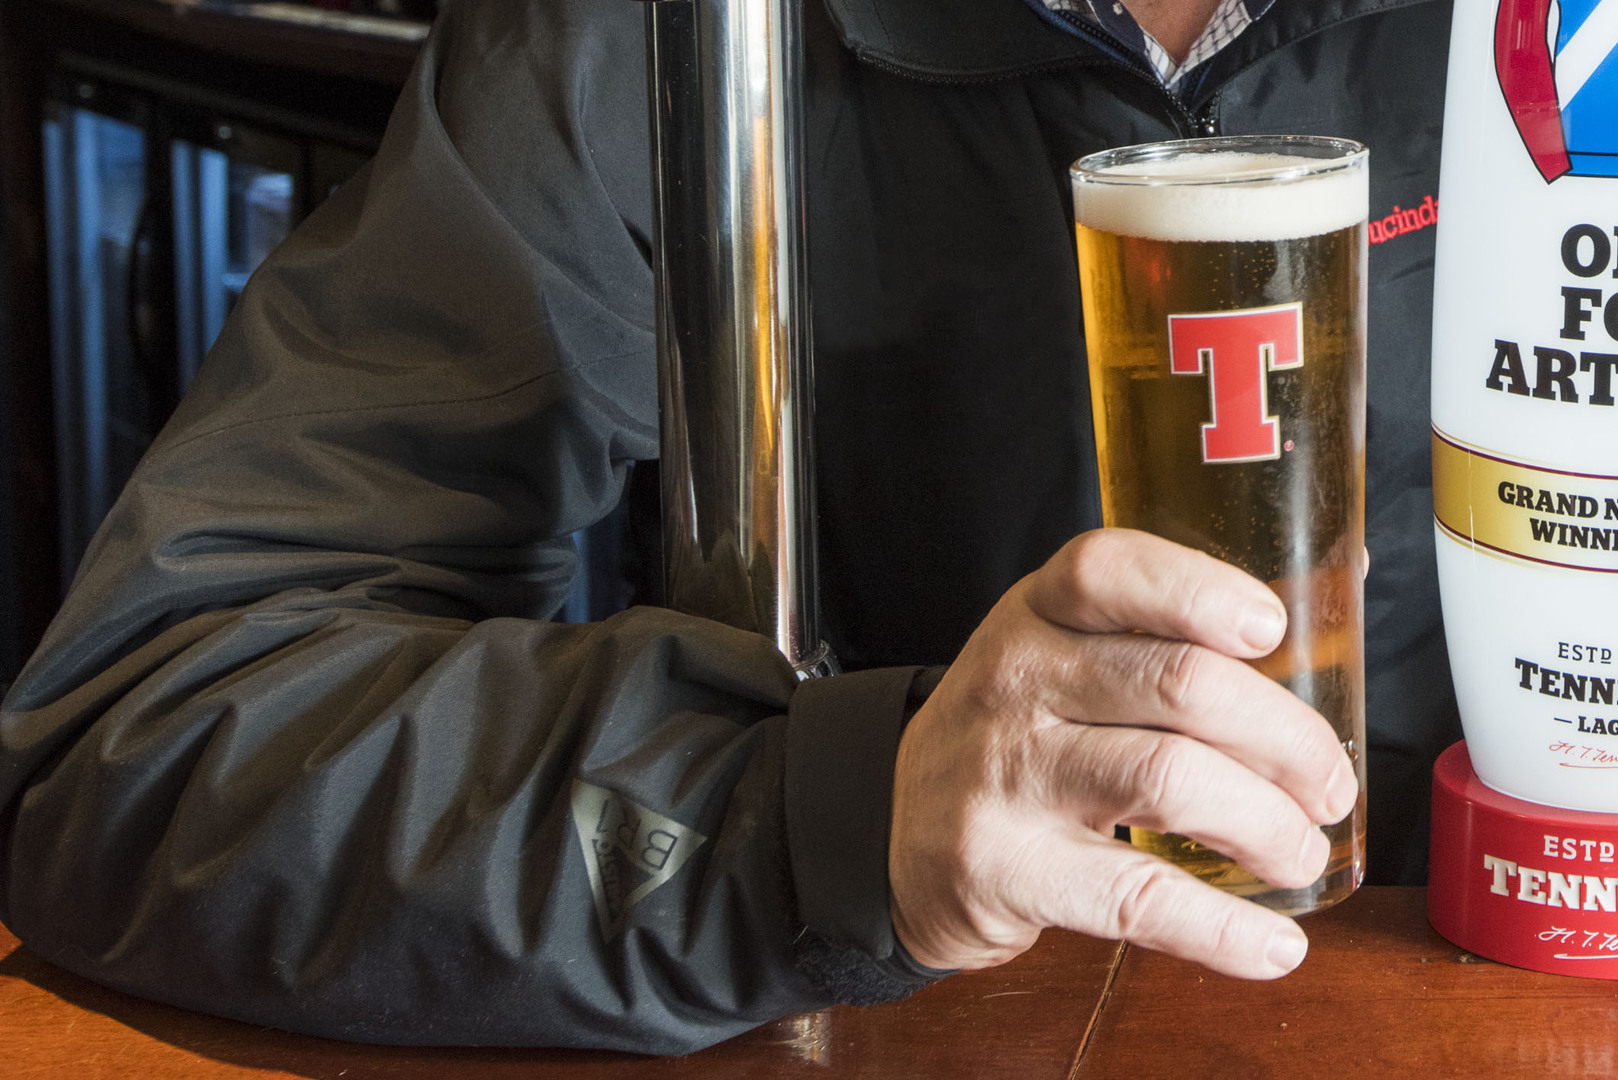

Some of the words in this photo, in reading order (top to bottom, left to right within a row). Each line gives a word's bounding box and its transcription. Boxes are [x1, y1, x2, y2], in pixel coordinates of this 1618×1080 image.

[1368, 195, 1439, 246] ucind
[1168, 301, 1304, 464] T
[1497, 480, 1599, 519] GRAND
